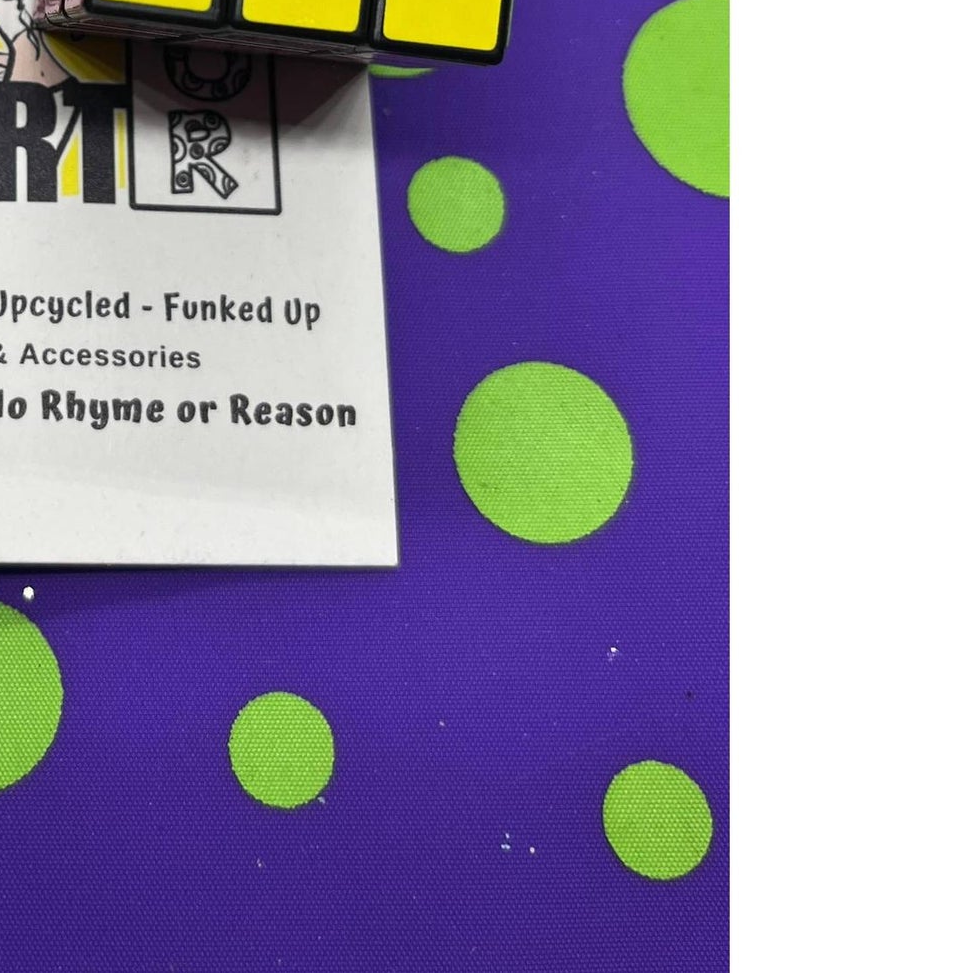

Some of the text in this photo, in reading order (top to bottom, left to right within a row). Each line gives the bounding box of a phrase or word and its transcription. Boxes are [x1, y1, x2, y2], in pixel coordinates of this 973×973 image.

[163, 292, 273, 324] Funked
[284, 297, 321, 331] Up
[19, 343, 201, 369] Accessories
[41, 389, 165, 431] Rhyme
[176, 400, 218, 424] or
[229, 393, 357, 428] Reason
